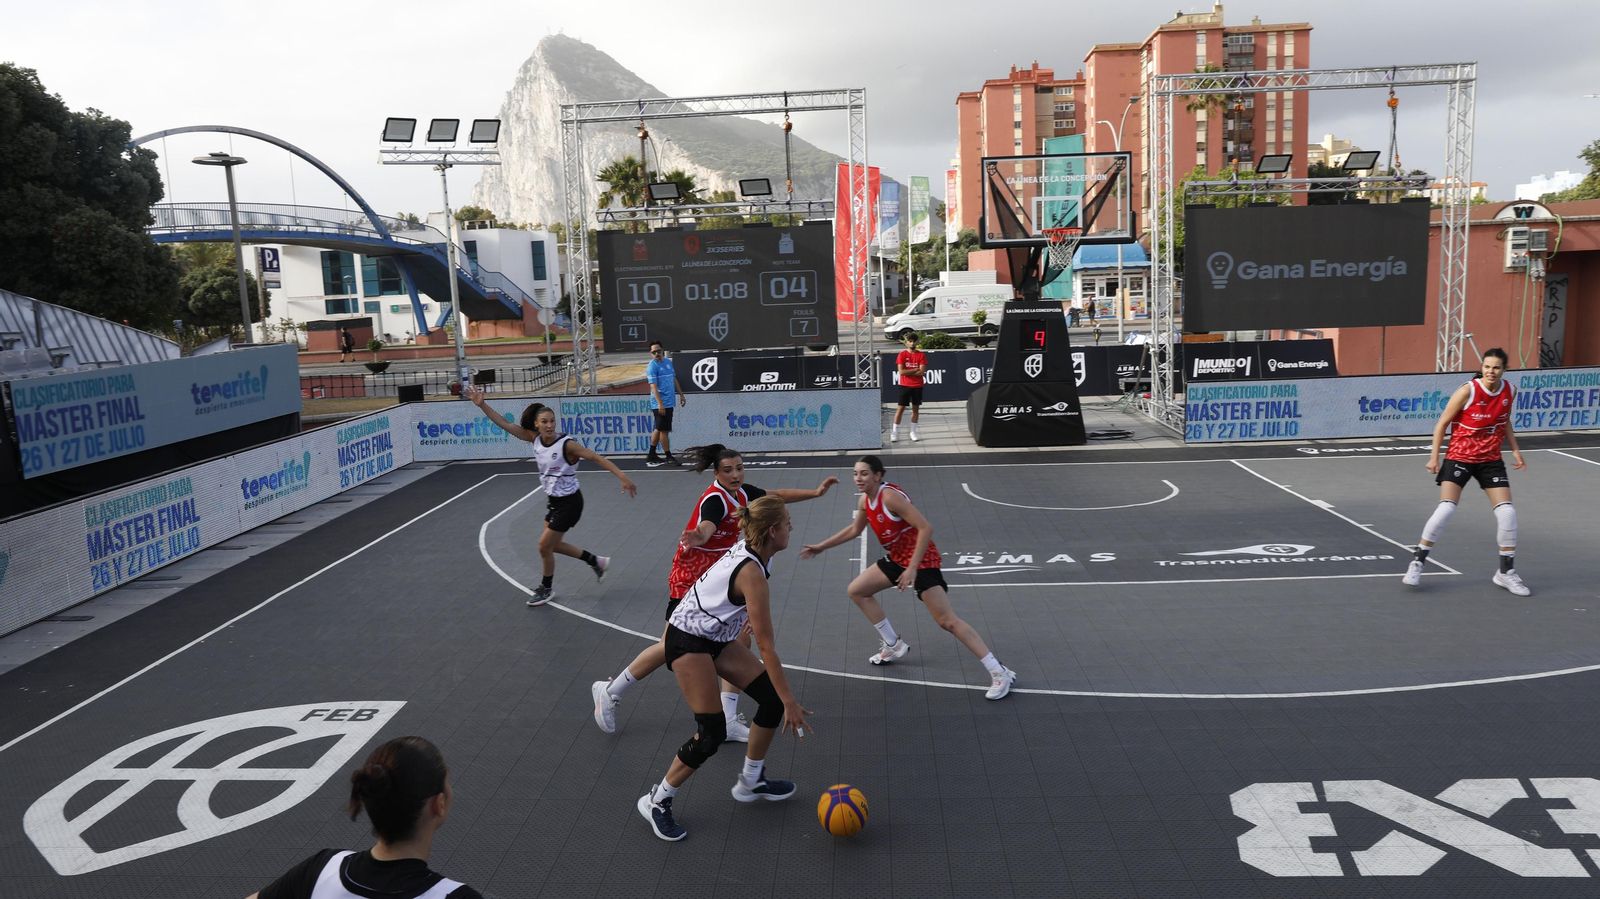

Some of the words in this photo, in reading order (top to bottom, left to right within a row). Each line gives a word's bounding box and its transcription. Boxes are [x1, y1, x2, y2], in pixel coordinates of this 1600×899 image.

[1061, 173, 1107, 182] CONCEPCIÓN
[264, 249, 273, 268] P
[1237, 261, 1304, 280] Gana
[1310, 256, 1407, 282] Energía
[628, 283, 660, 304] 10
[685, 282, 748, 300] 01:08
[770, 276, 808, 299] 04
[628, 327, 638, 339] 4
[799, 320, 809, 333] 7
[1035, 331, 1045, 346] 9
[1199, 358, 1246, 368] MUNDO
[1299, 360, 1328, 369] Energía
[14, 378, 106, 409] CLASIFICATORIO
[107, 373, 136, 395] PARA
[1188, 385, 1268, 401] CLASIFICATORIO
[1270, 384, 1297, 398] PARA
[1516, 387, 1585, 410] MÁSTER
[561, 400, 637, 415] CLASIFICATORIO
[640, 400, 652, 412] PA
[1186, 399, 1251, 421] MÁSTER
[1256, 401, 1302, 419] FINAL
[15, 403, 94, 443] MÁSTER
[96, 396, 145, 428] FINAL
[561, 414, 623, 435] MÁSTER
[1515, 412, 1532, 428] 26
[1536, 412, 1546, 427] Y
[1548, 411, 1568, 427] 27
[1570, 410, 1590, 426] DE
[337, 420, 376, 444] CLASIFICATORIO
[377, 416, 390, 431] PARA
[1186, 424, 1202, 439] 26
[1206, 423, 1215, 438] Y
[1218, 423, 1236, 439] 27
[1240, 422, 1257, 438] DE
[1260, 421, 1298, 437] JULIO
[21, 446, 43, 474] 26
[45, 442, 56, 467] Y
[61, 437, 80, 464] 27
[84, 433, 106, 459] DE
[108, 424, 145, 454] JULIO
[338, 439, 371, 468] MÁSTER
[372, 432, 393, 455] FINAL
[594, 437, 610, 452] 27
[614, 436, 630, 452] DE
[340, 470, 350, 489] 26
[350, 467, 355, 484] Y
[356, 463, 365, 482] 27
[366, 458, 375, 479] DE
[376, 452, 393, 474] JULIO
[85, 484, 167, 528] CLASIFICATORIO
[168, 476, 193, 501] PARA
[86, 512, 155, 562] MÁSTER
[158, 498, 200, 536] FINAL
[91, 562, 111, 592] 26
[113, 556, 122, 580] Y
[127, 548, 143, 577] 27
[146, 540, 165, 568] DE
[168, 526, 200, 560] JULIO
[956, 553, 1117, 565] RMAS
[1154, 554, 1394, 566] Trasmediterránea
[299, 708, 380, 721] FEB
